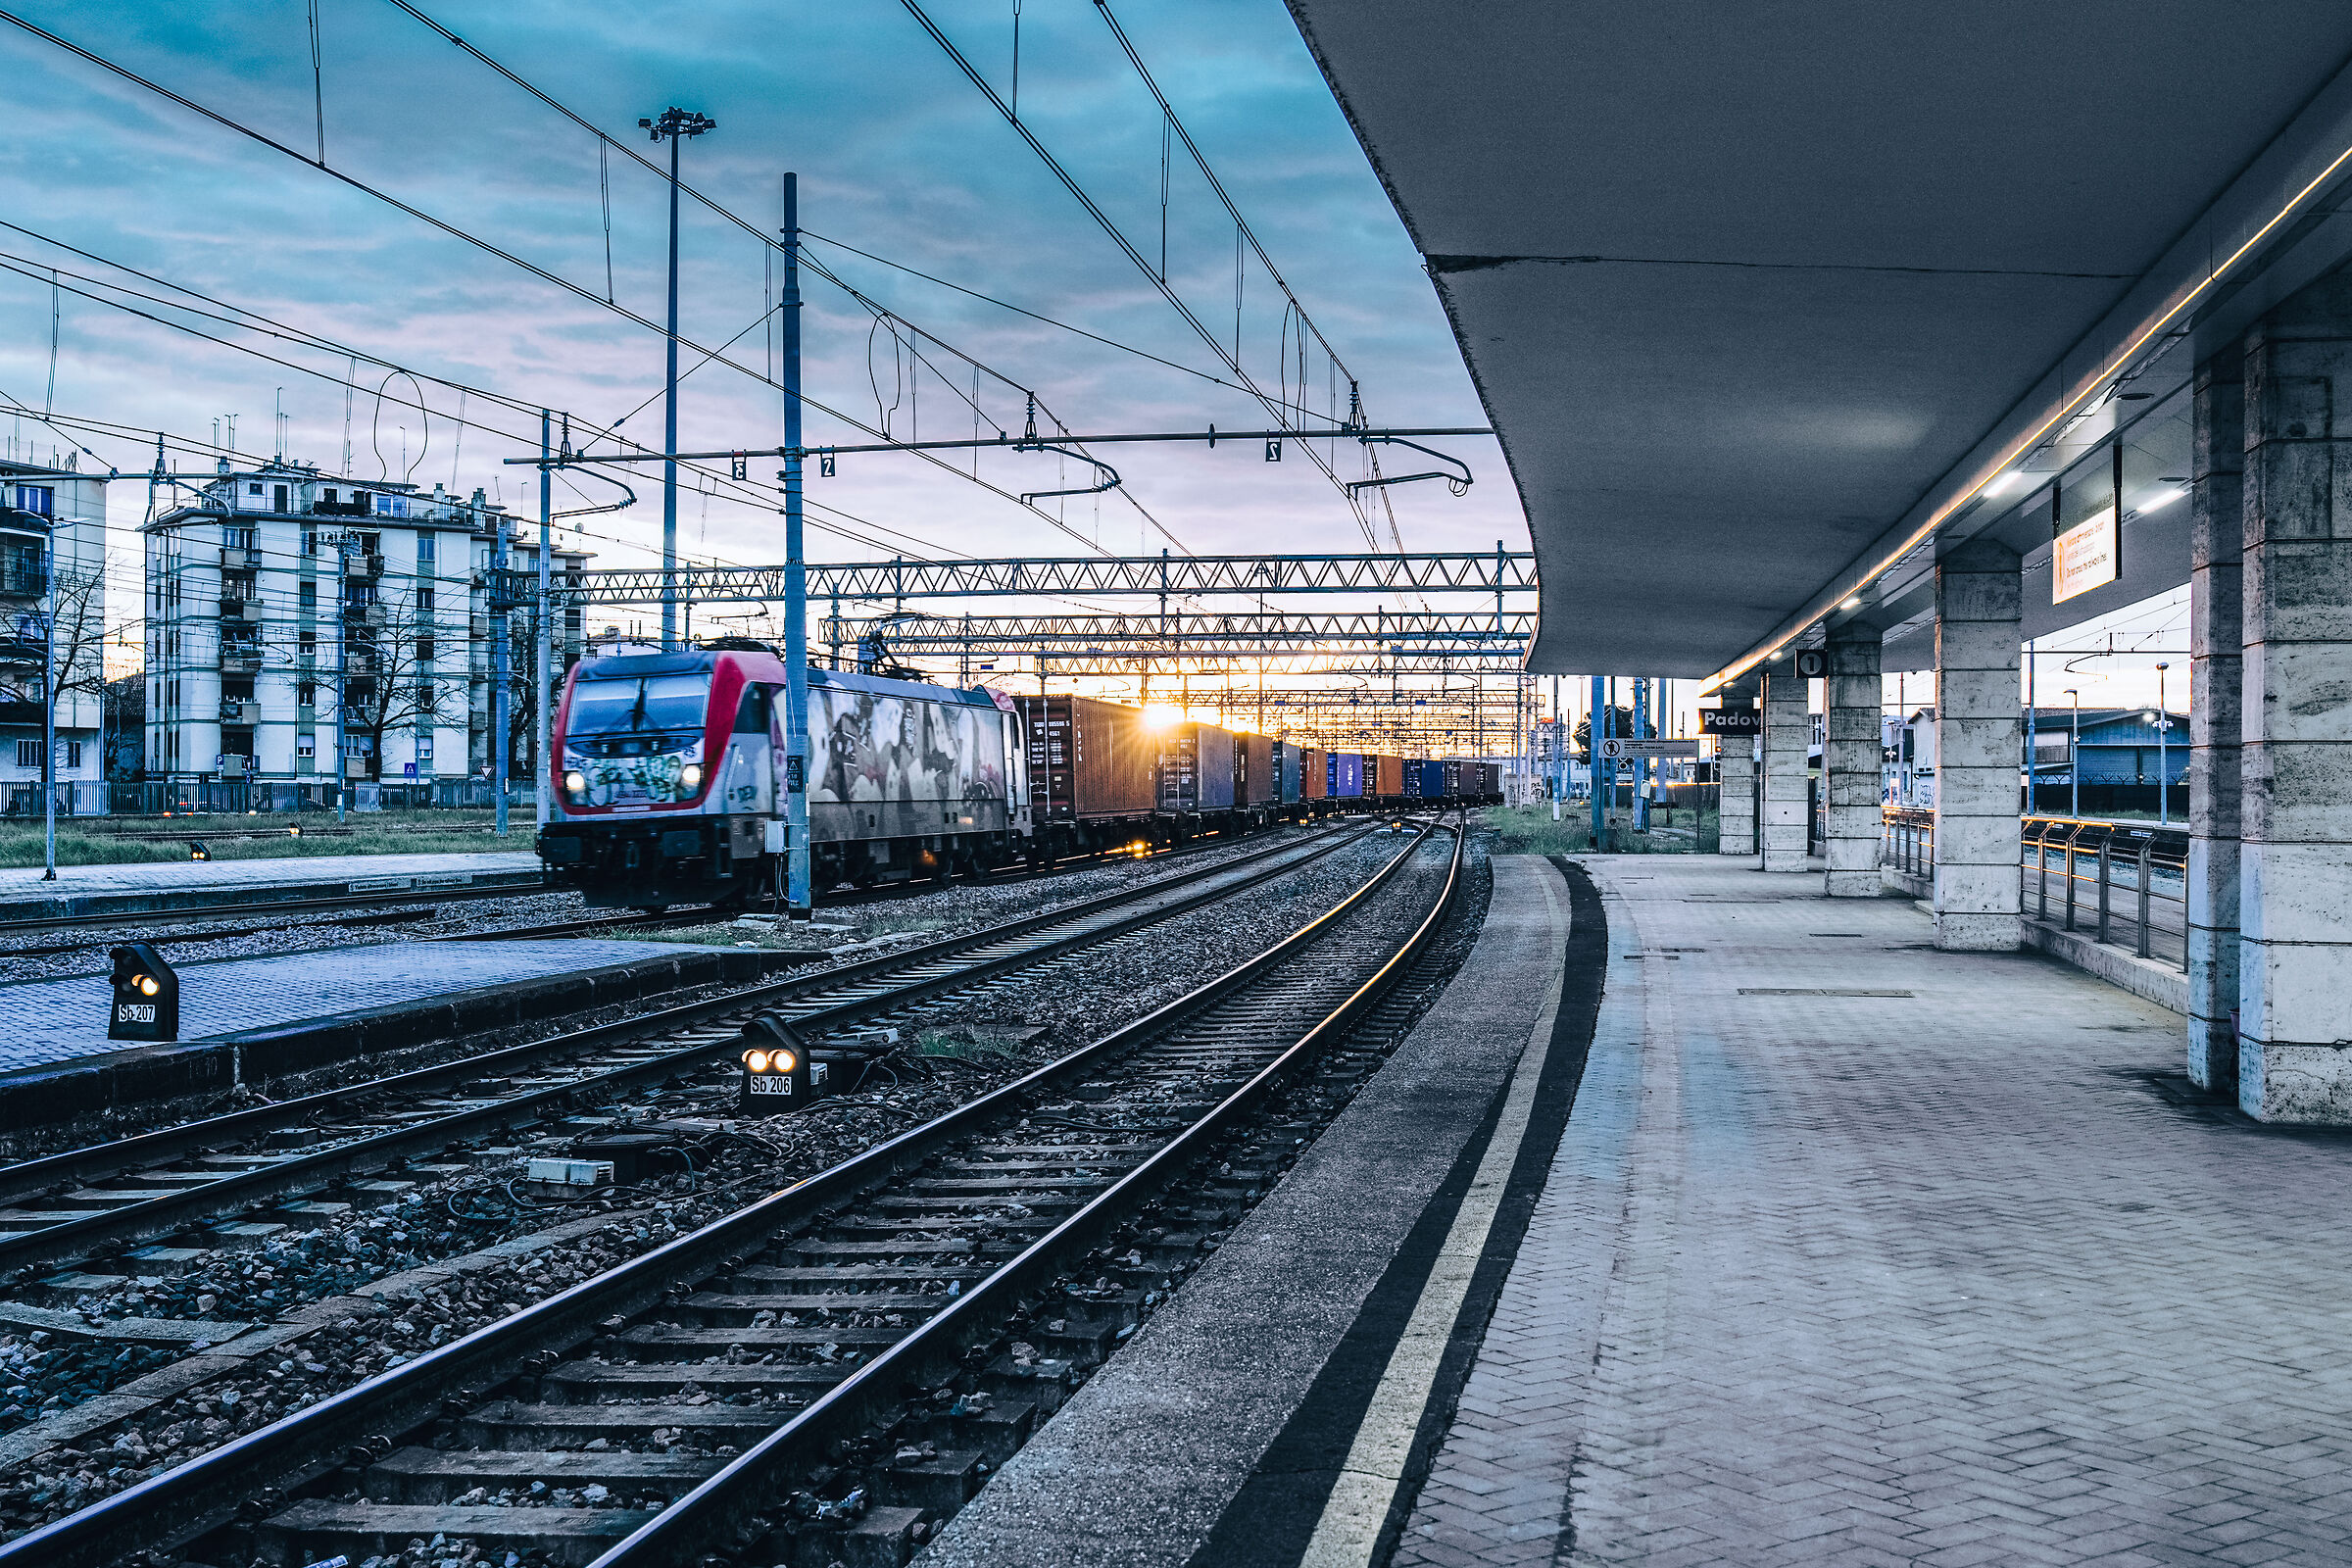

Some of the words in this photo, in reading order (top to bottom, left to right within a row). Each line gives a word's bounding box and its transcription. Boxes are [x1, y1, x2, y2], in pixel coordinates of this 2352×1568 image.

[823, 459, 832, 476] 2
[1807, 656, 1815, 671] 1
[1705, 711, 1761, 726] Padov
[217, 756, 222, 764] P
[120, 1005, 133, 1020] Sb
[136, 1005, 154, 1021] 207
[752, 1076, 767, 1093] Sb
[770, 1077, 790, 1094] 206
